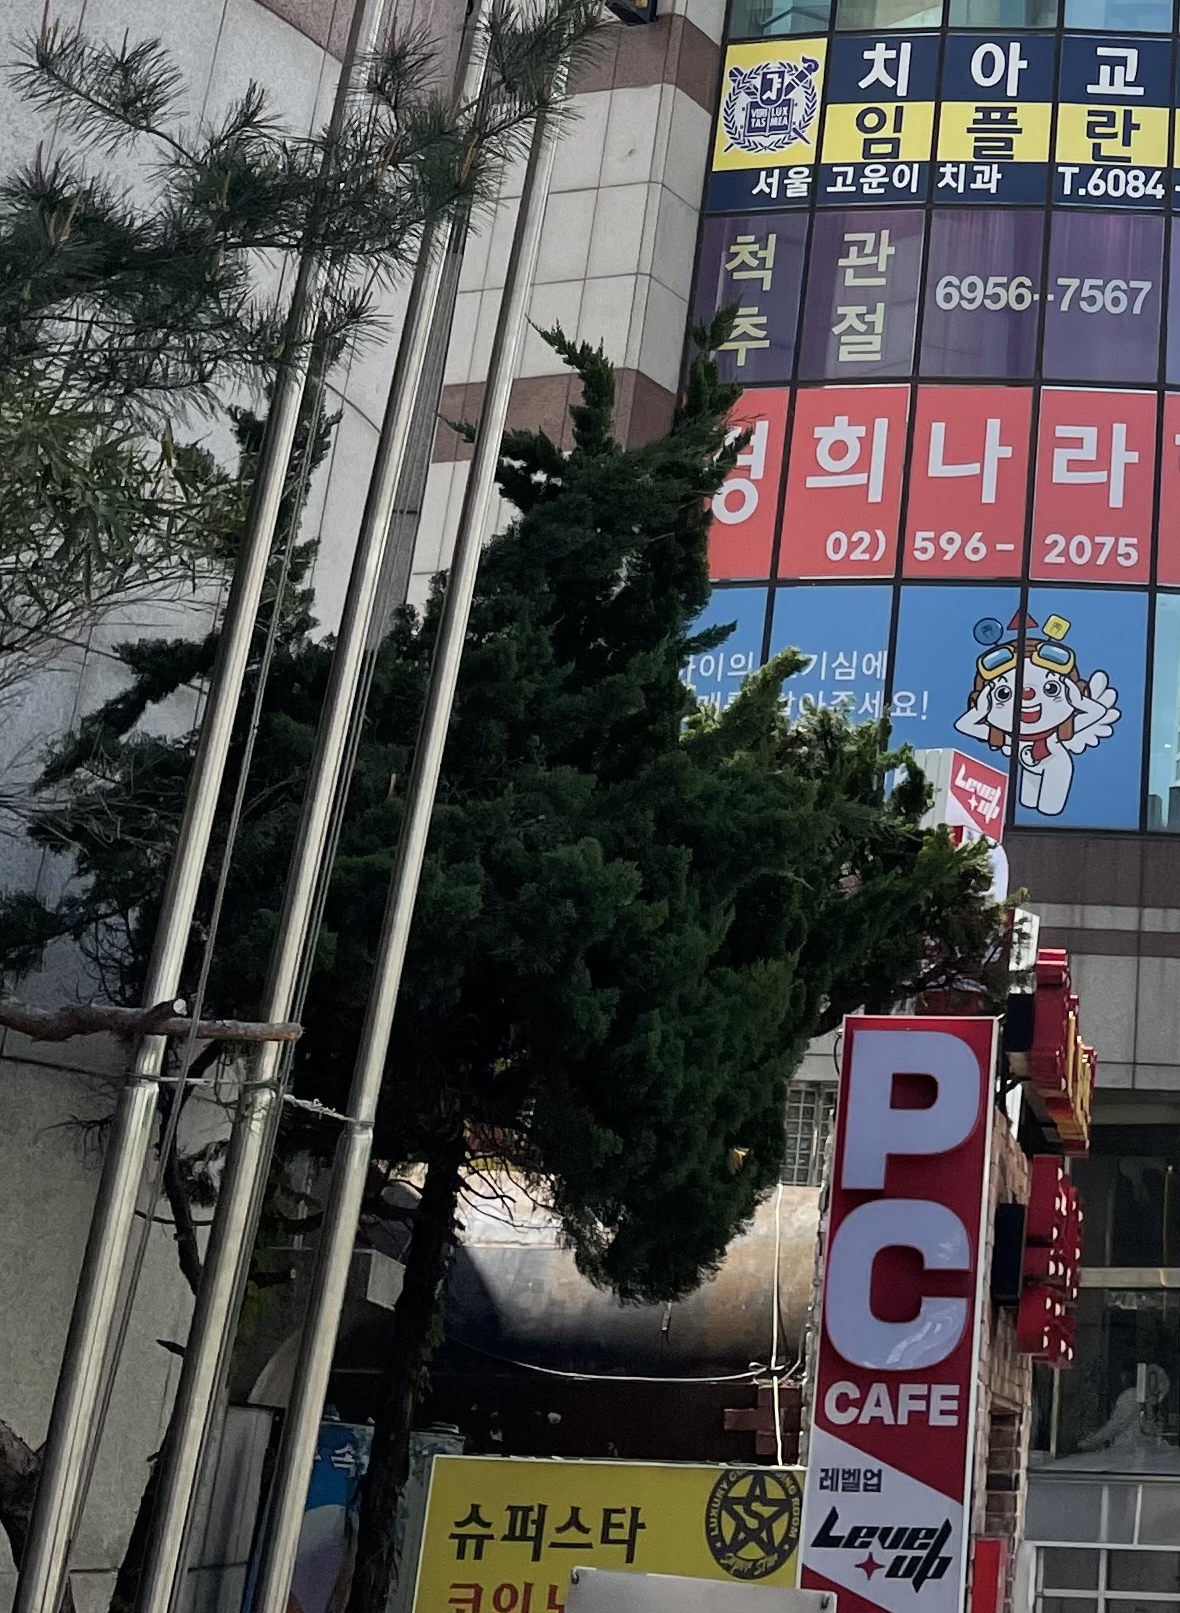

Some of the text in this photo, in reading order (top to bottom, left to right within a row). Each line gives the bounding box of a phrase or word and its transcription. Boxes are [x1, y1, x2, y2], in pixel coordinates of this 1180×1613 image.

[751, 167, 814, 199] 서울
[826, 166, 920, 194] 고운이
[938, 164, 1003, 195] 치과
[825, 530, 887, 562] 02)
[823, 1382, 960, 1427] CAFE
[818, 1467, 883, 1493] 레벨업
[448, 1502, 647, 1564] 슈퍼스타
